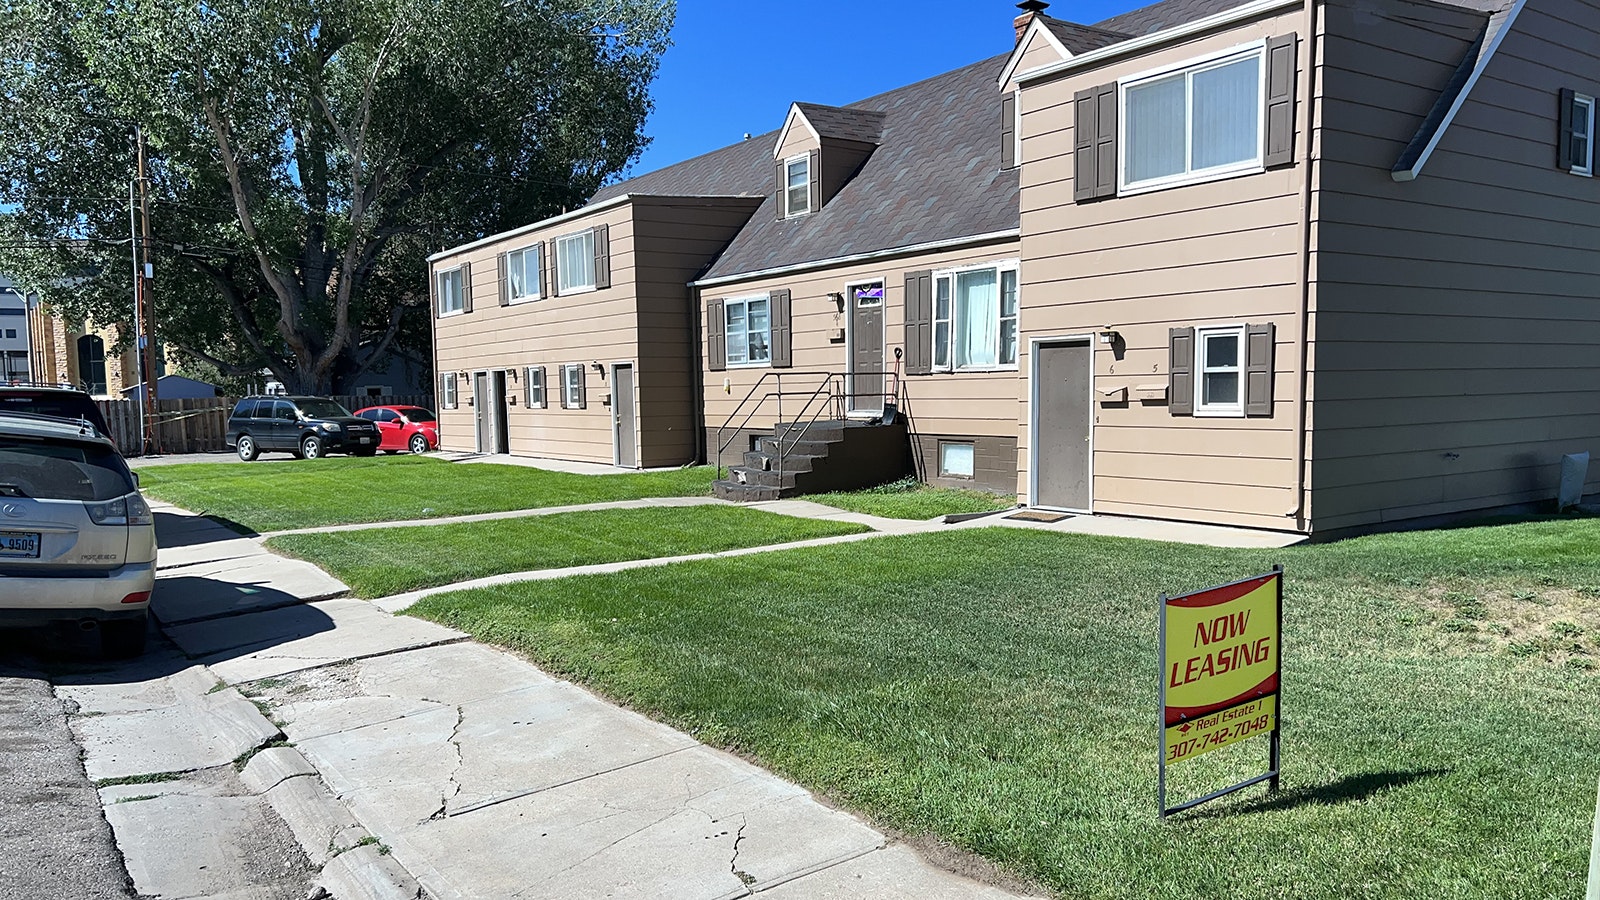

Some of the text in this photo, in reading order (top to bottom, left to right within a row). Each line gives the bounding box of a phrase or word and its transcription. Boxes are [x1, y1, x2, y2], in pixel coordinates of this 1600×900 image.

[1109, 364, 1114, 374] 6
[1152, 364, 1158, 373] 5
[8, 538, 34, 551] 9509
[1194, 609, 1250, 648] NOW
[1169, 637, 1270, 688] LEASING
[1196, 714, 1219, 731] Real
[1222, 705, 1255, 722] Estate
[1167, 714, 1269, 761] 307-742-7048
